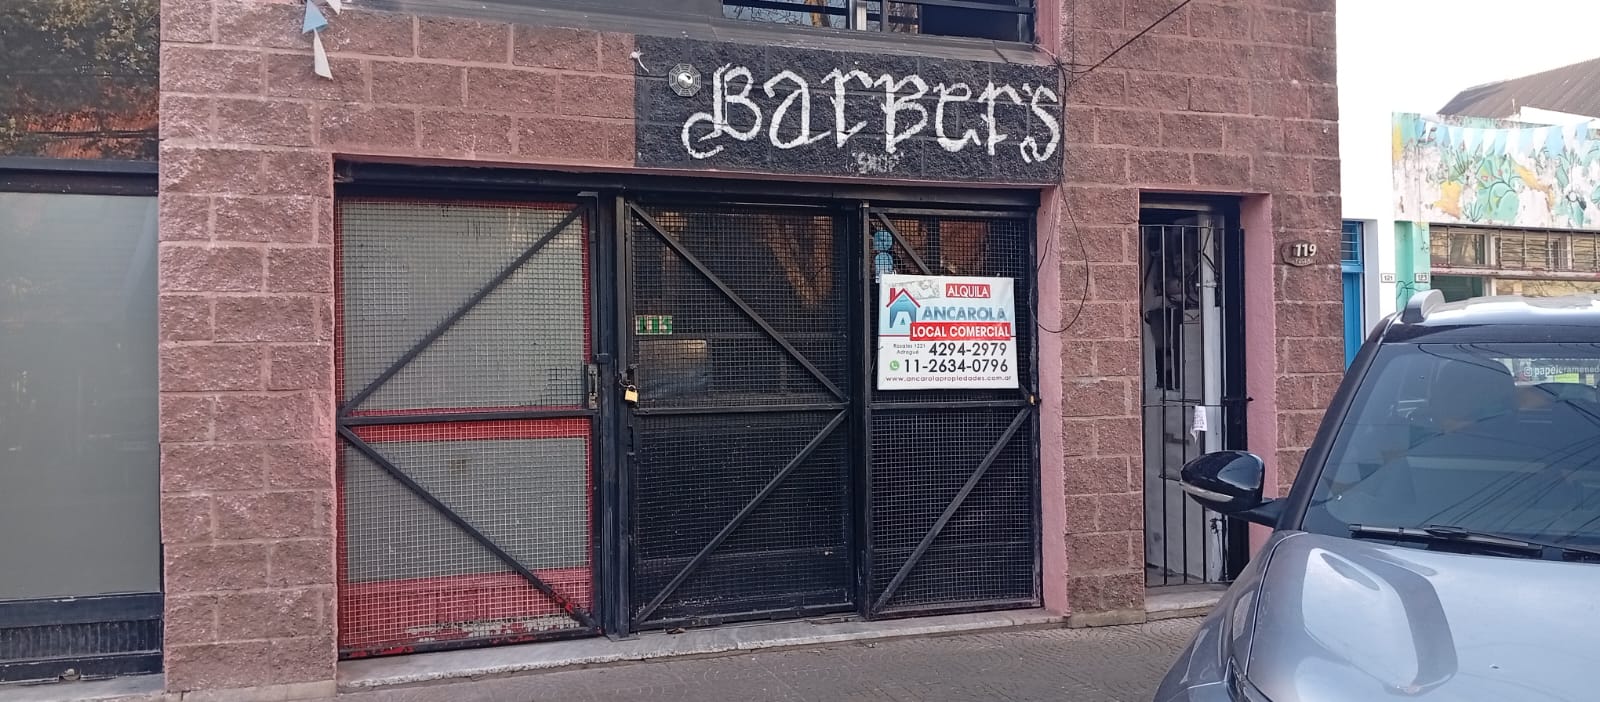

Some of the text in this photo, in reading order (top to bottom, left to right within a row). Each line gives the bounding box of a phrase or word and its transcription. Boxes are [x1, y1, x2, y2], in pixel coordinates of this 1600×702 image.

[1295, 243, 1317, 257] 119
[946, 285, 990, 297] ALQUILA
[921, 306, 1008, 321] ANCAROLA
[912, 325, 1010, 338] LOCAL COMERCIAL
[929, 342, 1007, 357] 4294-2979
[904, 358, 1009, 373] 11-2634-0796
[886, 375, 1012, 383] www.ancarolapropiedades.com.ar
